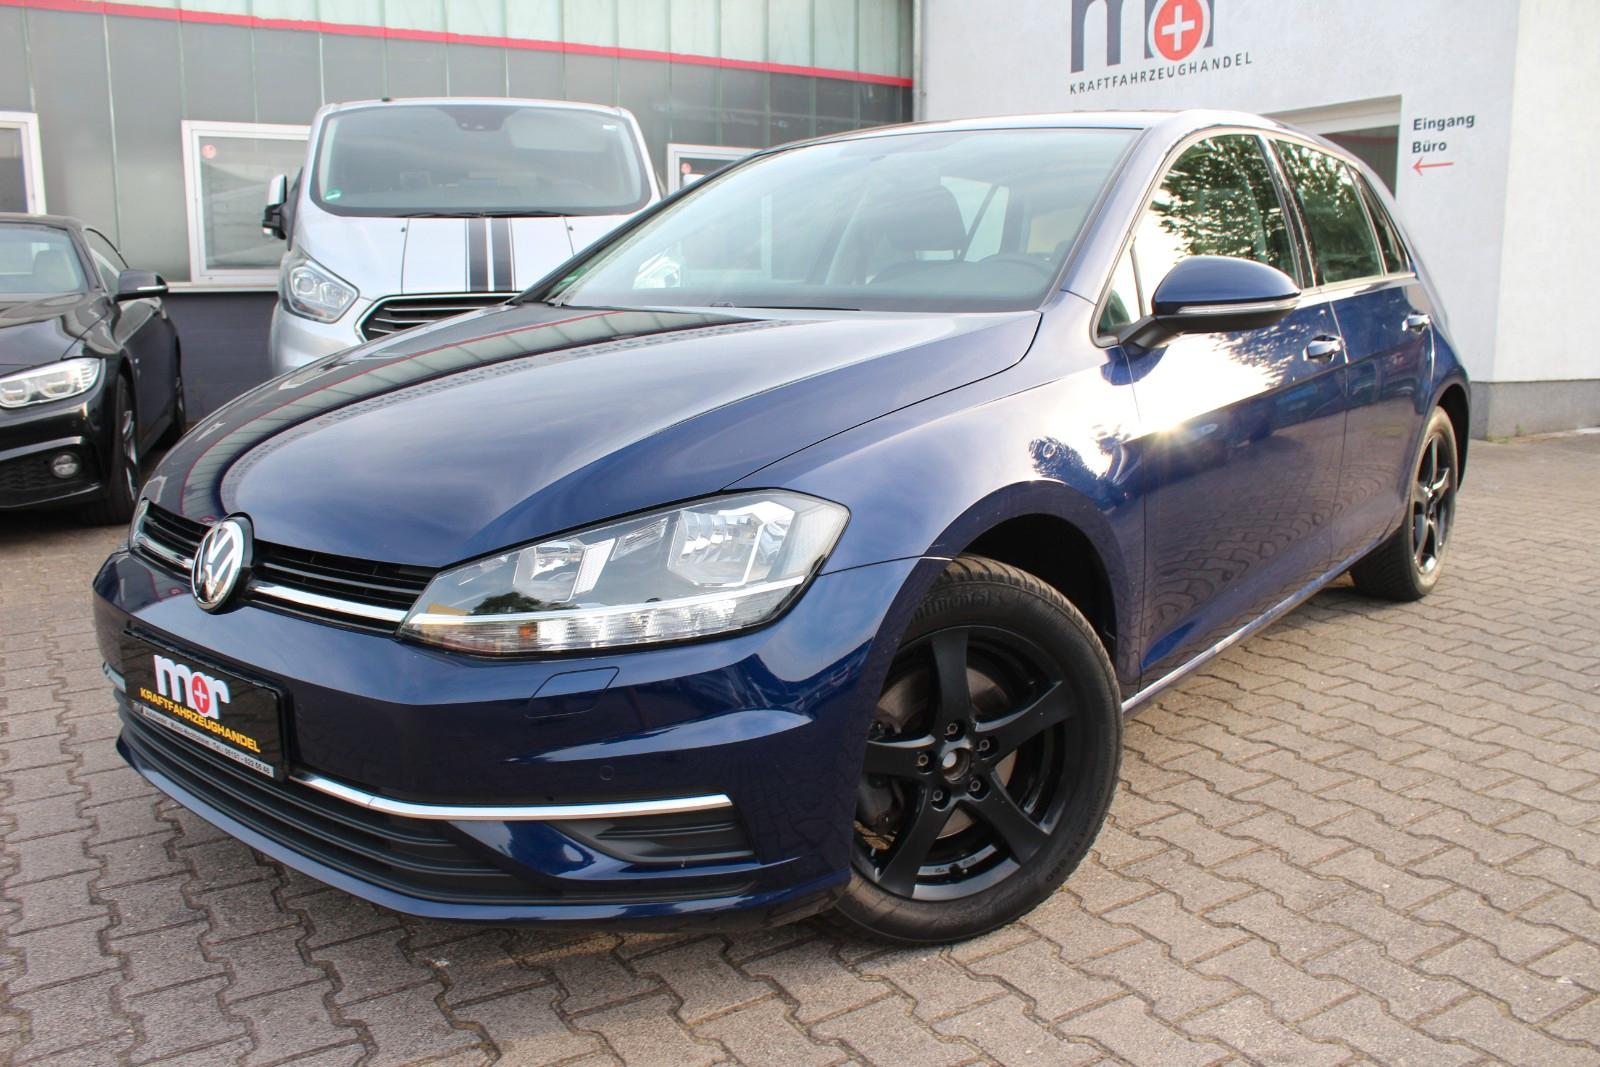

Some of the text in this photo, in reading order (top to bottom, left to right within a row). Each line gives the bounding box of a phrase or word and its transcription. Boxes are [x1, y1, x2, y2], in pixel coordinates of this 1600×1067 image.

[1070, 51, 1253, 95] KRAFTFAHRZEUGHANDEL
[1413, 114, 1475, 131] Eingang
[1412, 140, 1448, 154] Büro
[139, 687, 262, 754] KRAFTFAHRZEUGHANDEL
